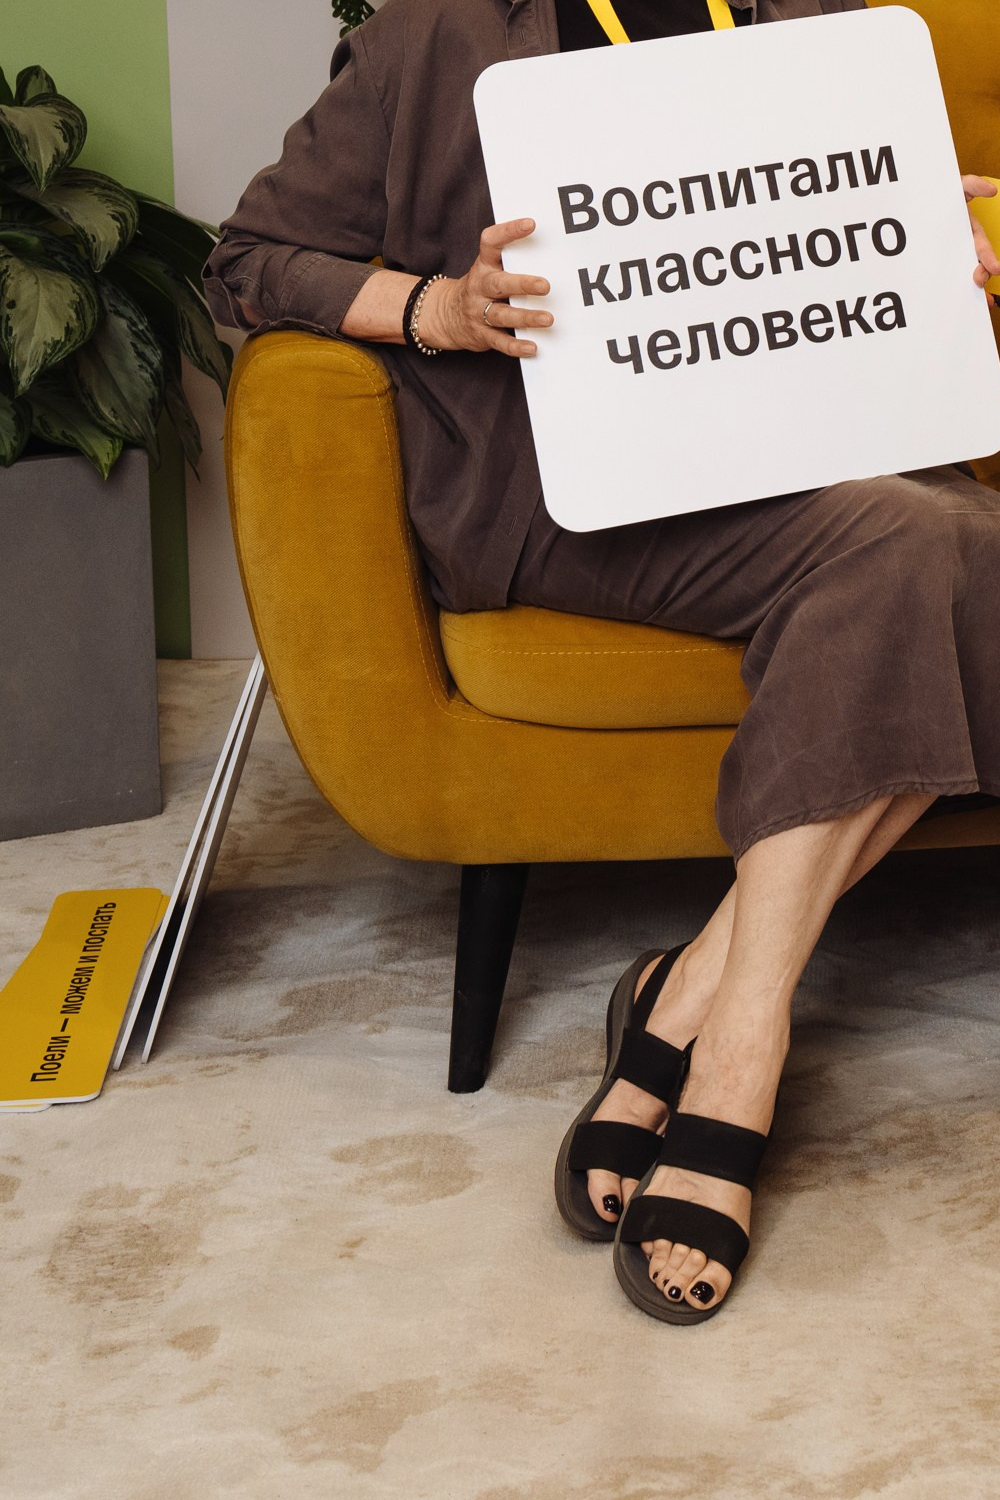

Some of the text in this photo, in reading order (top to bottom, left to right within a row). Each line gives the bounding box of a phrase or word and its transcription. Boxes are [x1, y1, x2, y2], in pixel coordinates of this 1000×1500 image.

[557, 145, 899, 235] Воспитали
[577, 217, 907, 307] классного
[606, 291, 907, 375] человека
[82, 902, 117, 953] поспать
[78, 955, 100, 964] и
[59, 965, 96, 1015] можем
[30, 1035, 72, 1082] Поели
